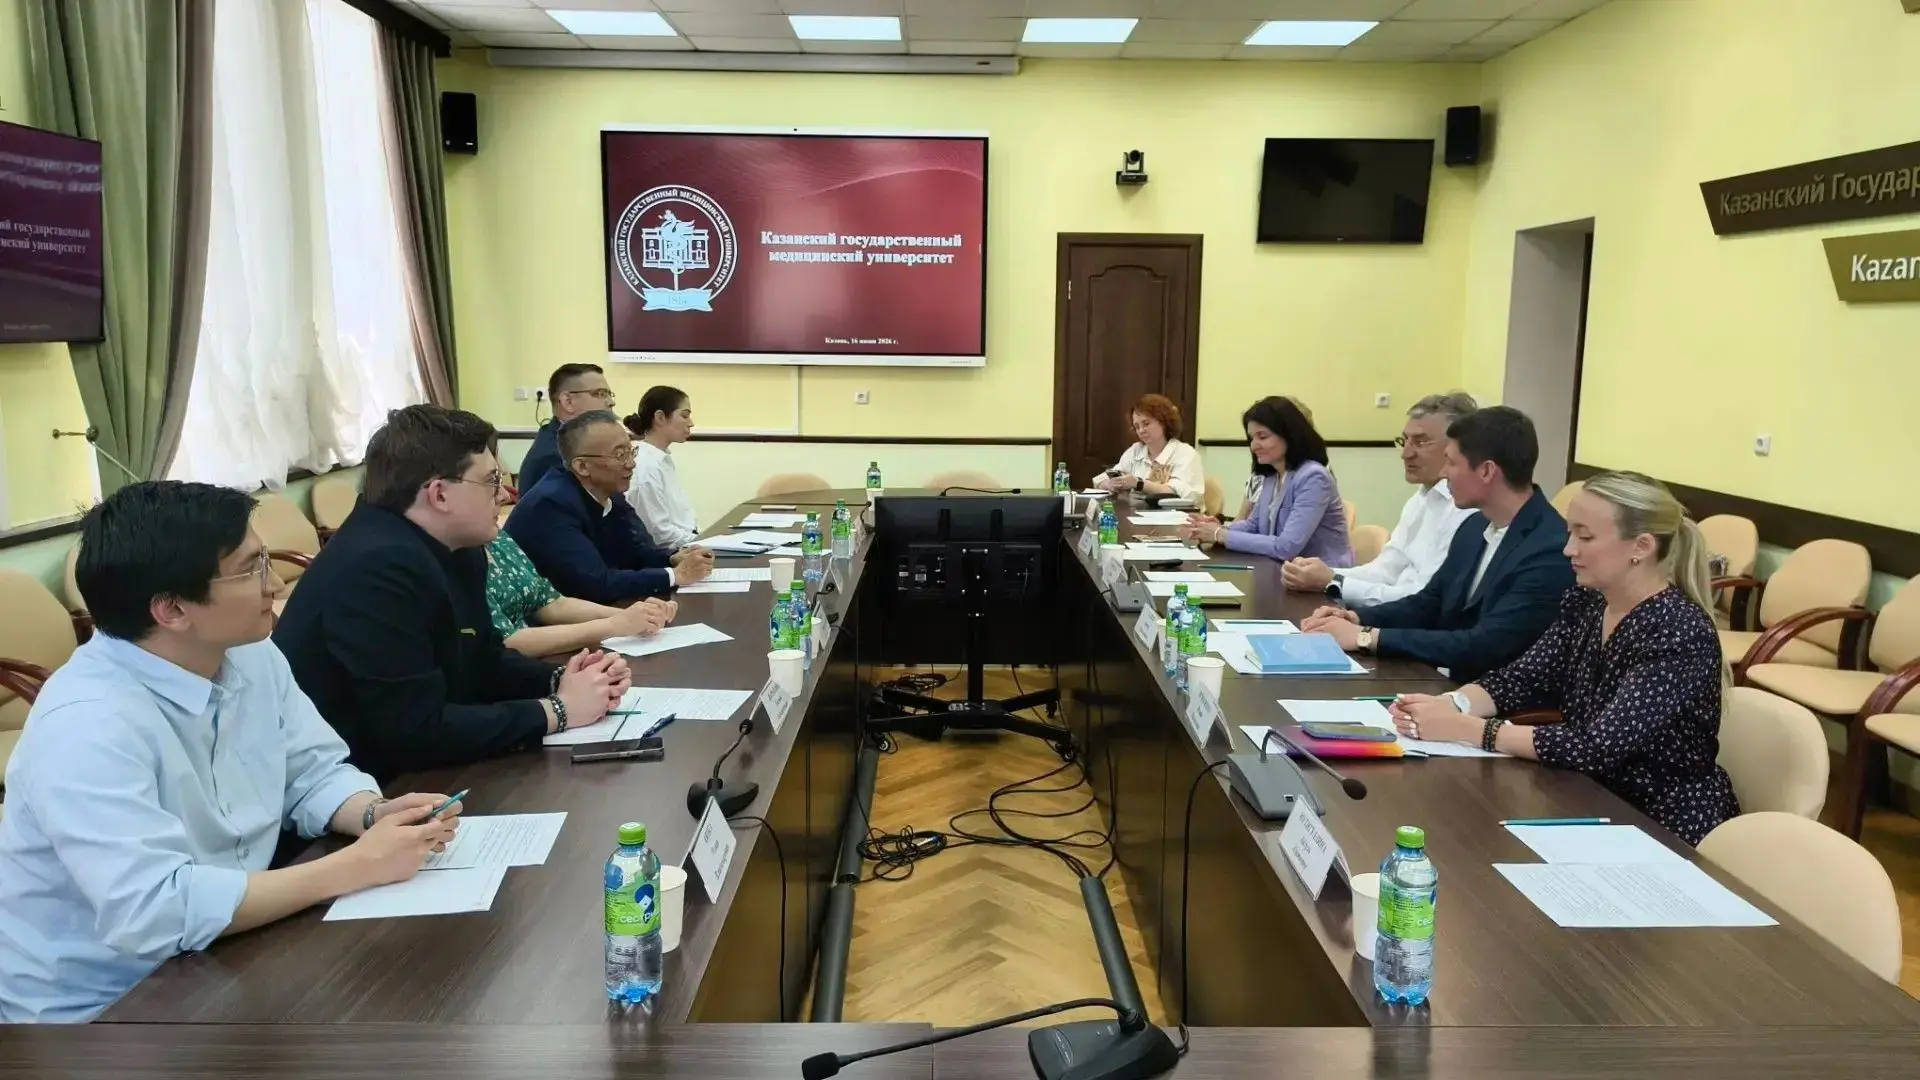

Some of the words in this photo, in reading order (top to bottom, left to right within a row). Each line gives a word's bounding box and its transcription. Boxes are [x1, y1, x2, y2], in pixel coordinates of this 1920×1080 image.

[1720, 174, 1825, 216] Казанский
[761, 231, 837, 245] Казанский
[840, 234, 962, 249] государственный
[769, 250, 864, 263] медицинский
[867, 252, 955, 266] университет
